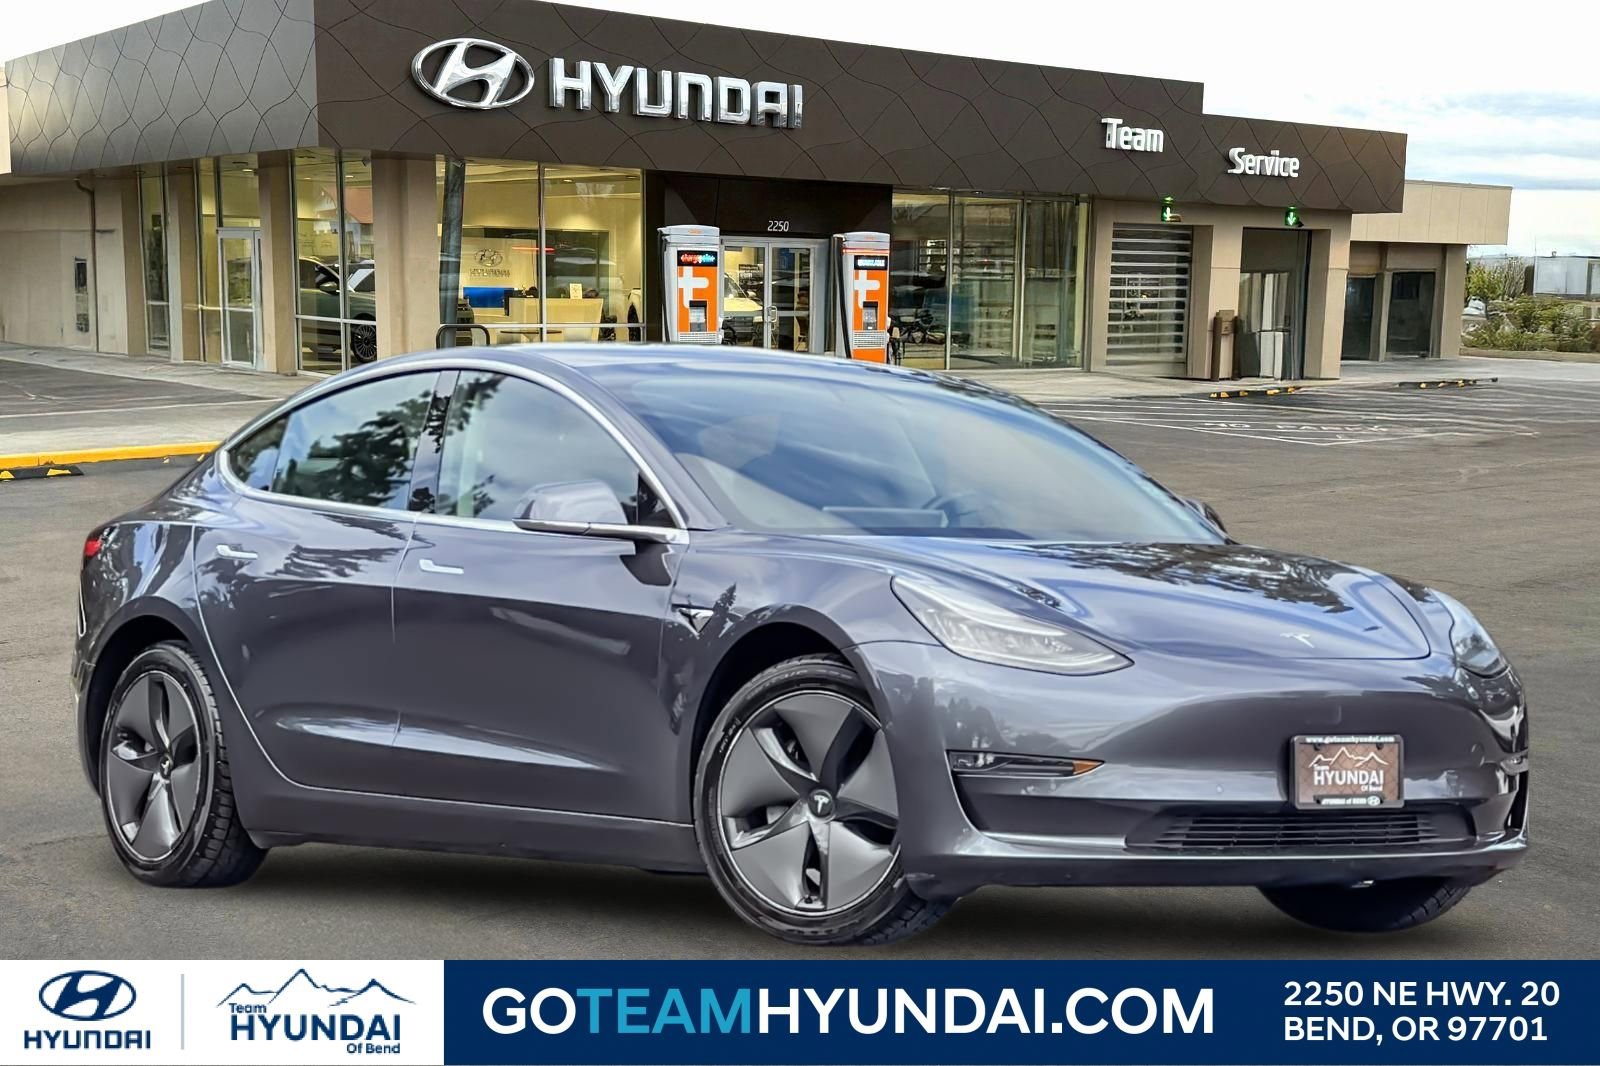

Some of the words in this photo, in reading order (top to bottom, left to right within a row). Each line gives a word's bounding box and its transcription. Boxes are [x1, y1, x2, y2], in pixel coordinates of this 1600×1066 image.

[549, 57, 804, 128] HYUNDAI
[1101, 117, 1164, 153] Team
[1227, 147, 1300, 178] Service
[767, 220, 790, 232] 2250
[1313, 770, 1384, 786] HYUNDAI
